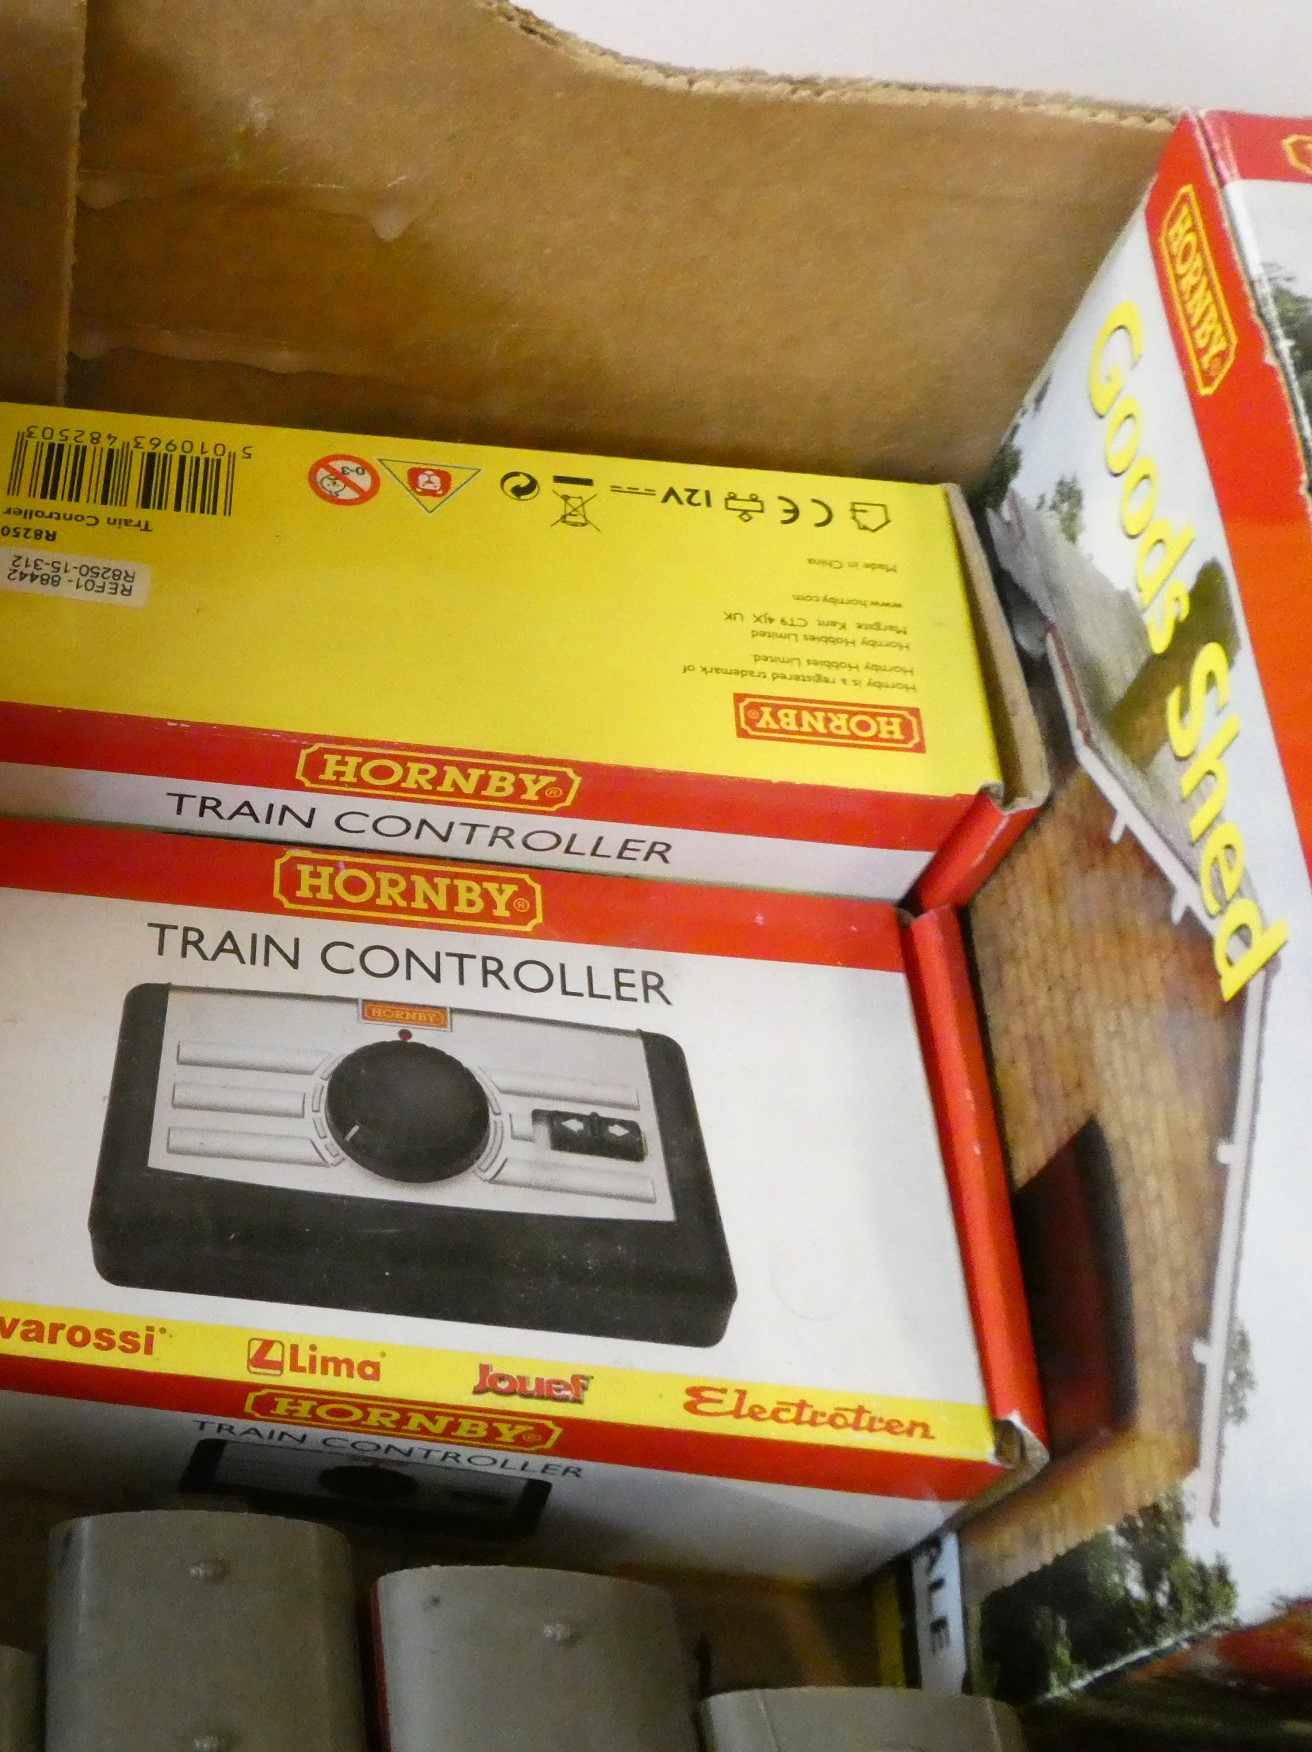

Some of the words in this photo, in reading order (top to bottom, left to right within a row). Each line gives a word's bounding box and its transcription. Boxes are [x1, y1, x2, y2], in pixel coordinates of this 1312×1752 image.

[1168, 203, 1228, 370] HORNBY
[661, 486, 712, 509] 12V
[2, 506, 100, 527] Controller
[106, 516, 153, 532] Train
[0, 525, 57, 542] R8250
[11, 554, 136, 583] R8250-15-312
[807, 557, 843, 570] China
[7, 567, 62, 587] 88442
[722, 611, 744, 622] UK
[780, 616, 808, 628] CT9
[816, 618, 847, 630] Kent
[750, 629, 799, 643] Limited
[855, 621, 908, 635] Margate
[803, 634, 856, 648] Hobbies
[860, 636, 910, 651] Hornby
[1088, 299, 1196, 655] Goods
[1166, 641, 1291, 1003] Shed
[681, 664, 695, 675] of
[699, 665, 766, 680] trademark
[806, 658, 859, 673] Hobbies
[864, 662, 914, 676] Hornby
[771, 671, 836, 685] registered
[866, 677, 917, 693] Hornby
[754, 706, 905, 741] HORNBY
[322, 754, 557, 804] HORNBY
[166, 792, 317, 829] TRAIN
[334, 810, 674, 865] CONTROLLER
[294, 862, 520, 919] HORNBY
[147, 922, 300, 970] TRAIN
[321, 940, 673, 1006] CONTROLLER
[288, 1343, 382, 1382] Lima
[472, 1363, 591, 1406] Jouef
[269, 1396, 536, 1445] HORNBY
[683, 1384, 937, 1441] Electrotren
[191, 1418, 307, 1446] TRAIN
[321, 1435, 584, 1480] CONTROLLER
